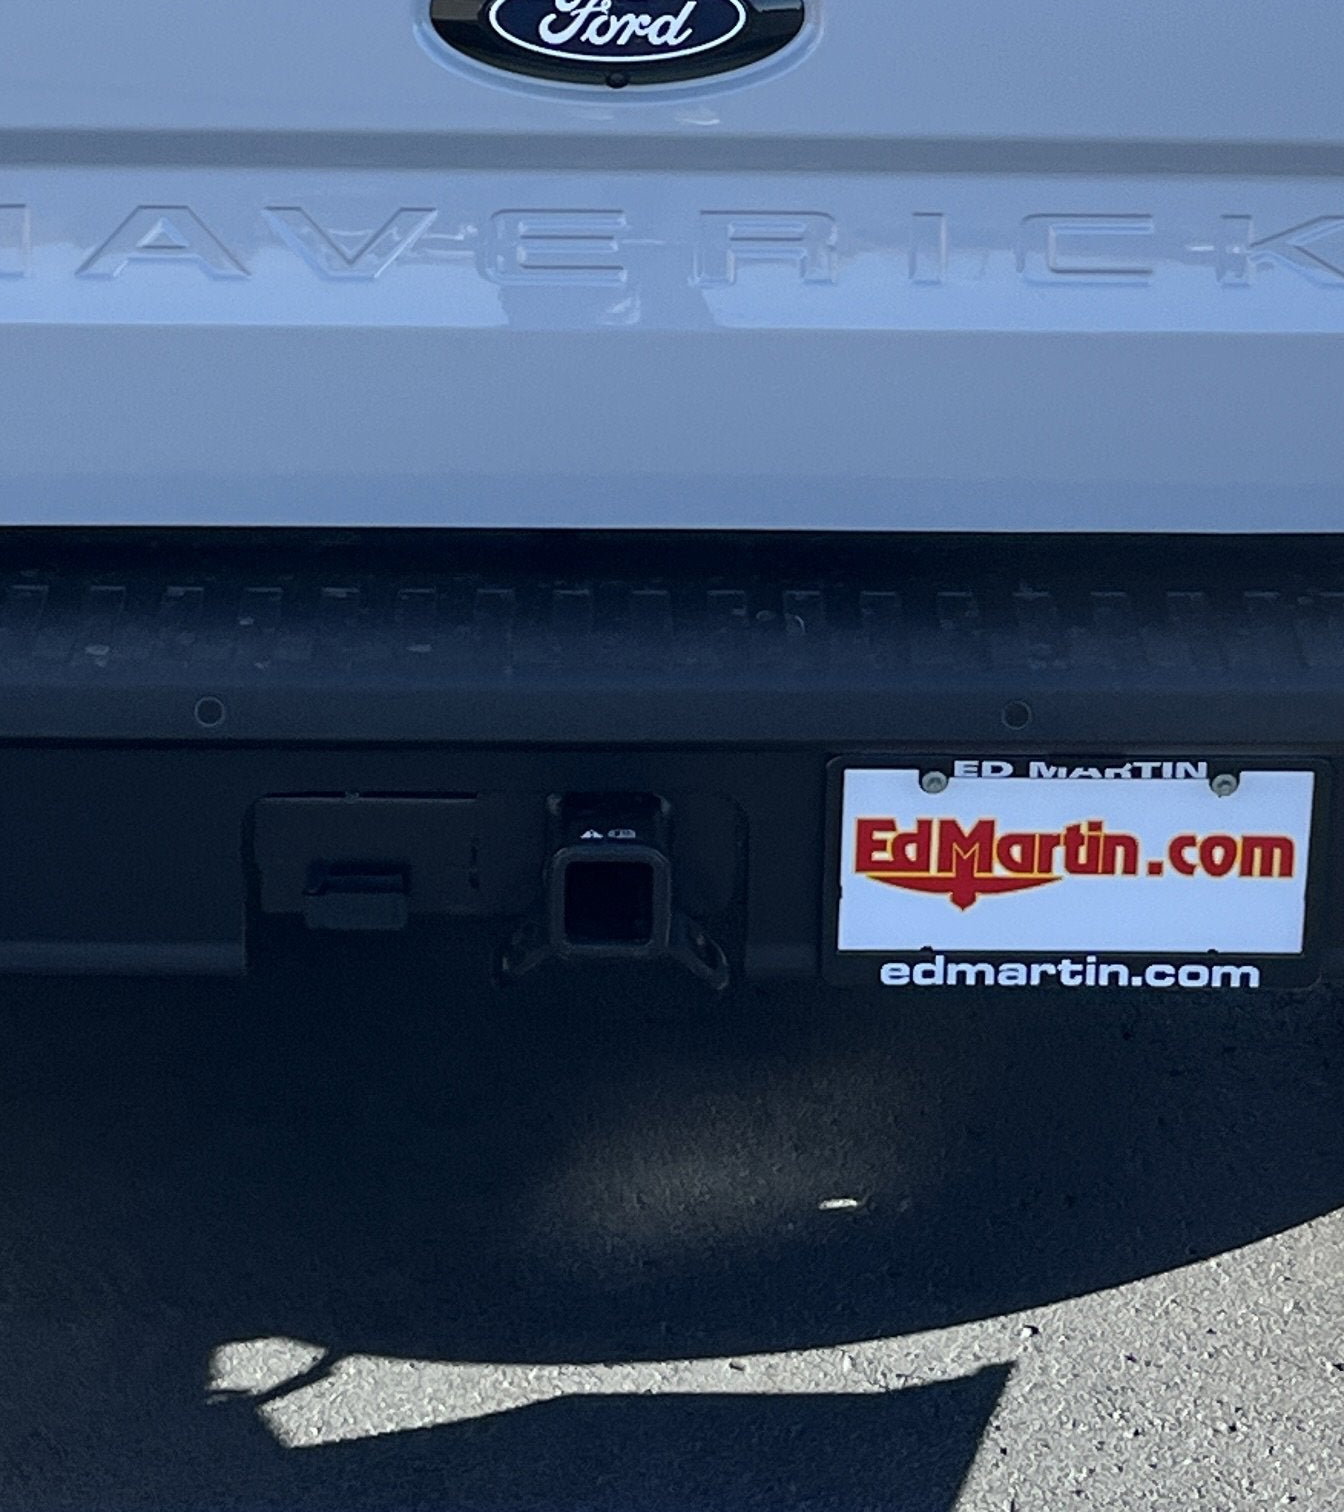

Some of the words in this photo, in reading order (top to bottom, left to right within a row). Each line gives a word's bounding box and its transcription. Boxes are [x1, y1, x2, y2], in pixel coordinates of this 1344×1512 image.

[953, 759, 1014, 779] ED
[854, 817, 1296, 879] EdMartin.com
[879, 955, 1260, 988] edmartin.com
